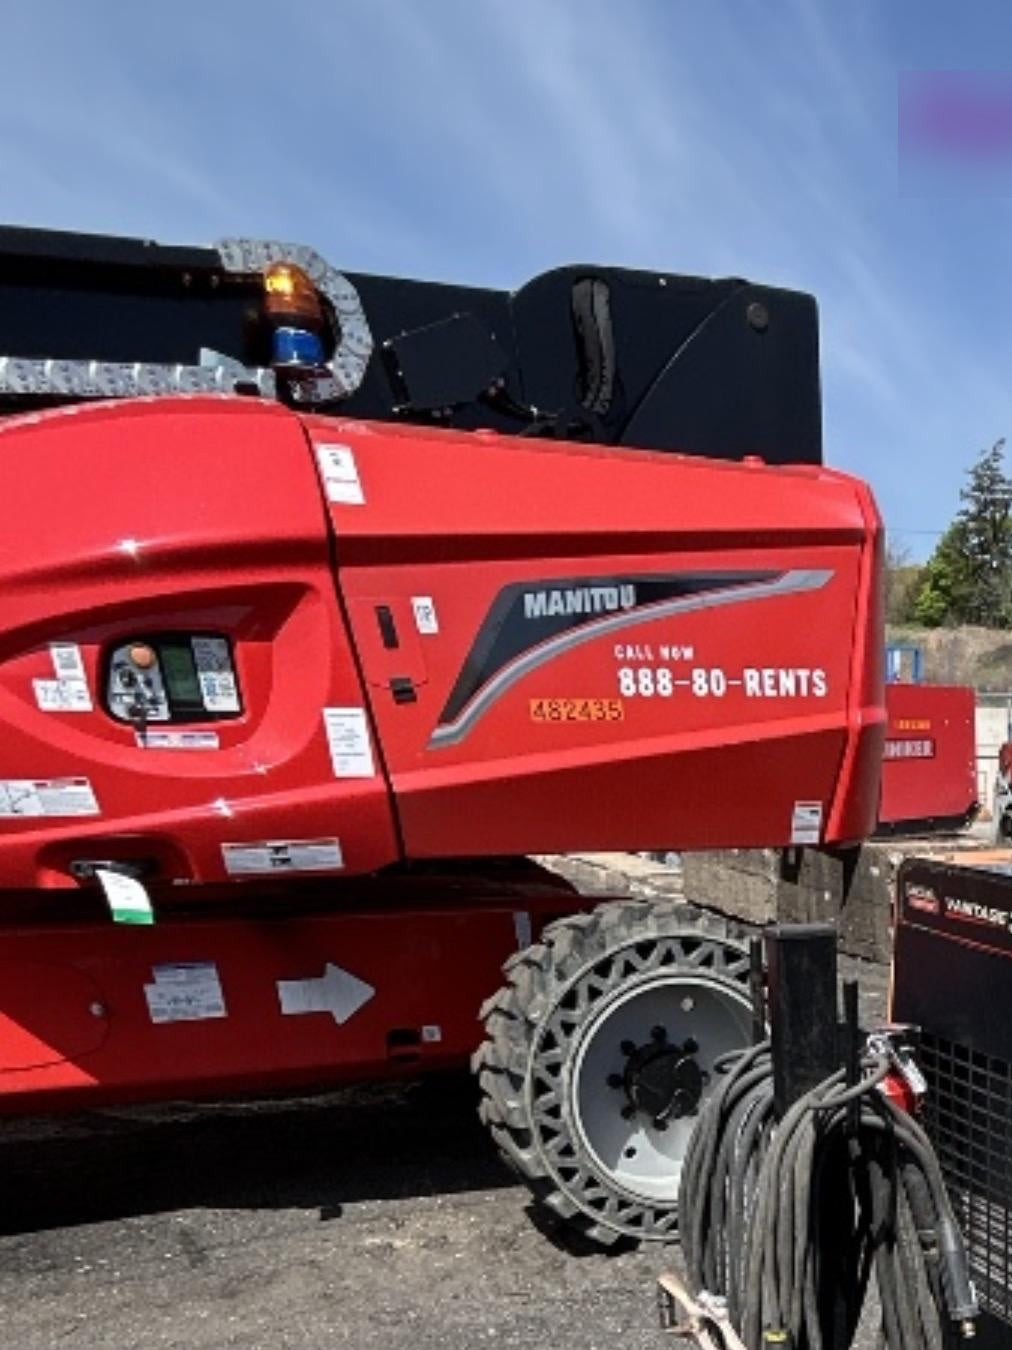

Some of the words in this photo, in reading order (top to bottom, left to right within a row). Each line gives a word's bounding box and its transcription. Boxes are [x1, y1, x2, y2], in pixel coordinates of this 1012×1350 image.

[524, 585, 636, 617] MANITOU
[614, 645, 654, 660] CALL
[617, 668, 827, 697] 888-80-RENTS
[533, 701, 622, 721] 482435
